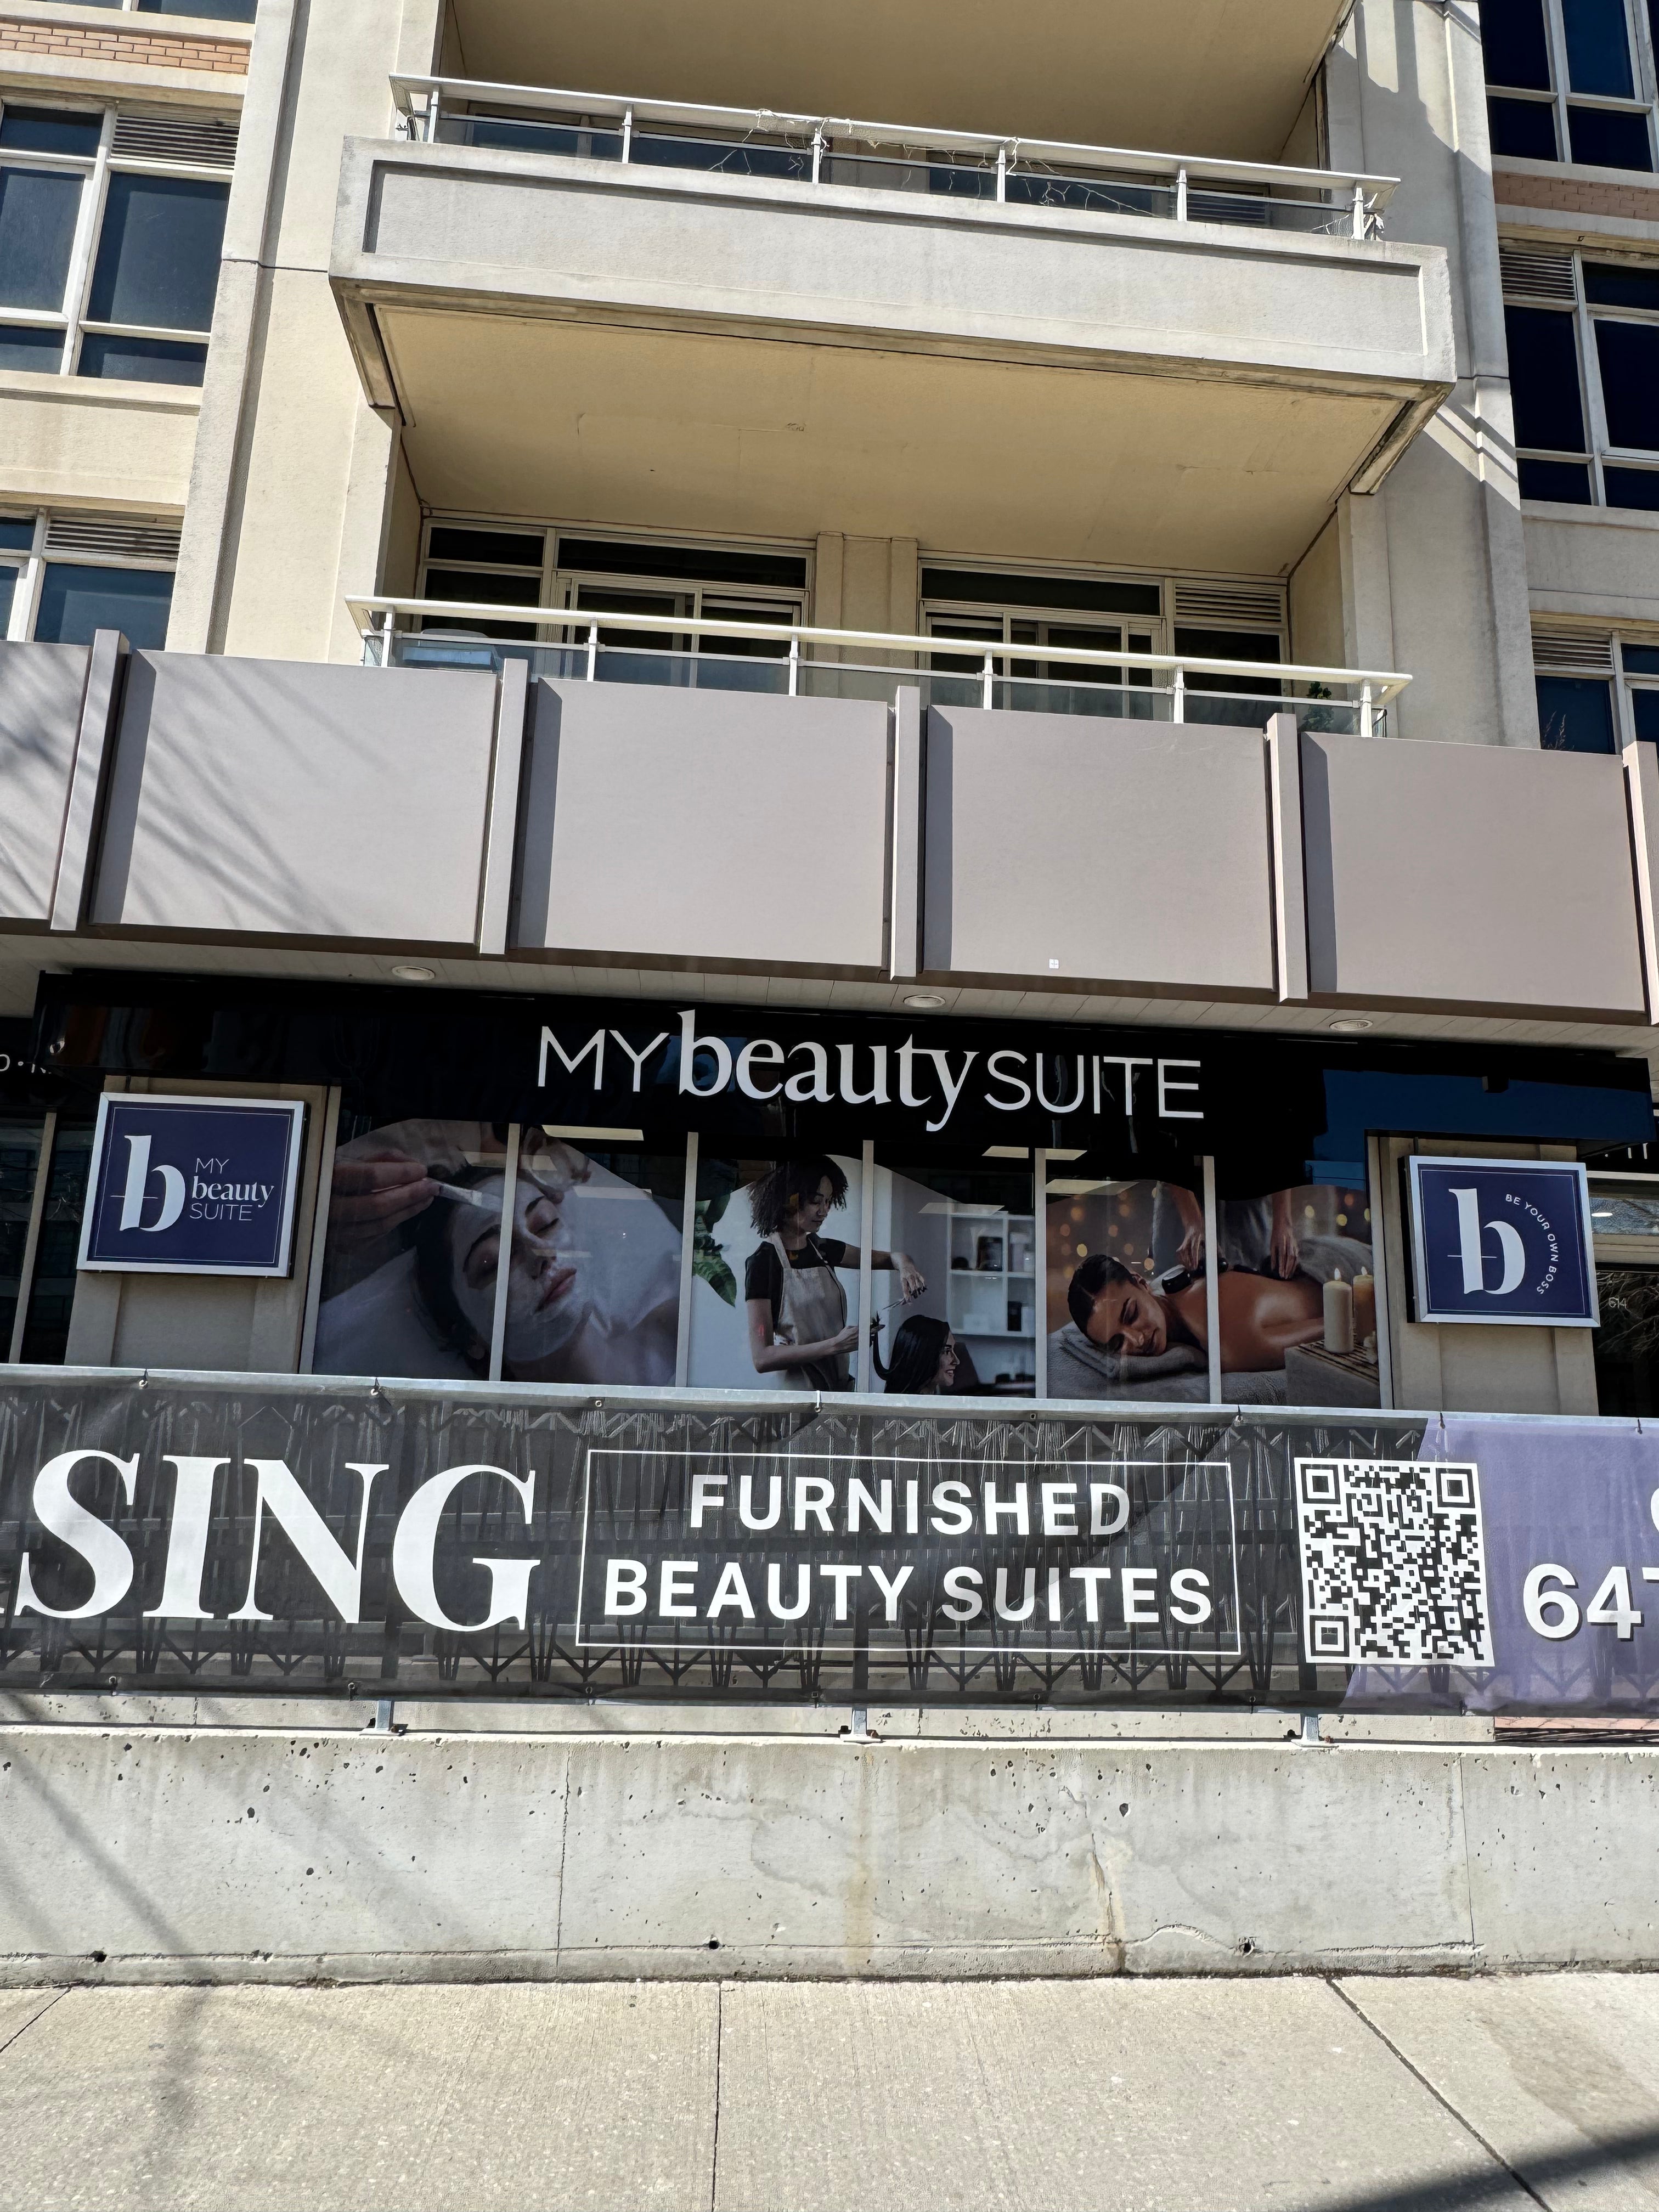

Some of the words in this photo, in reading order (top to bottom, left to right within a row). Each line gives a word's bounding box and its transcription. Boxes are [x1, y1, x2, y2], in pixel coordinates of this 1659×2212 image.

[195, 1158, 230, 1174] MY
[192, 1175, 274, 1208] beauty
[1505, 1193, 1521, 1206] BE
[189, 1203, 253, 1221] SUITE
[1524, 1201, 1550, 1230] YOUR
[1547, 1233, 1559, 1262] OWN
[1536, 1265, 1557, 1295] BOSS
[690, 1473, 1130, 1537] FURNISHED
[0, 1449, 541, 1632] SING
[603, 1558, 914, 1622] BEAUTY
[940, 1565, 1211, 1626] SUITES
